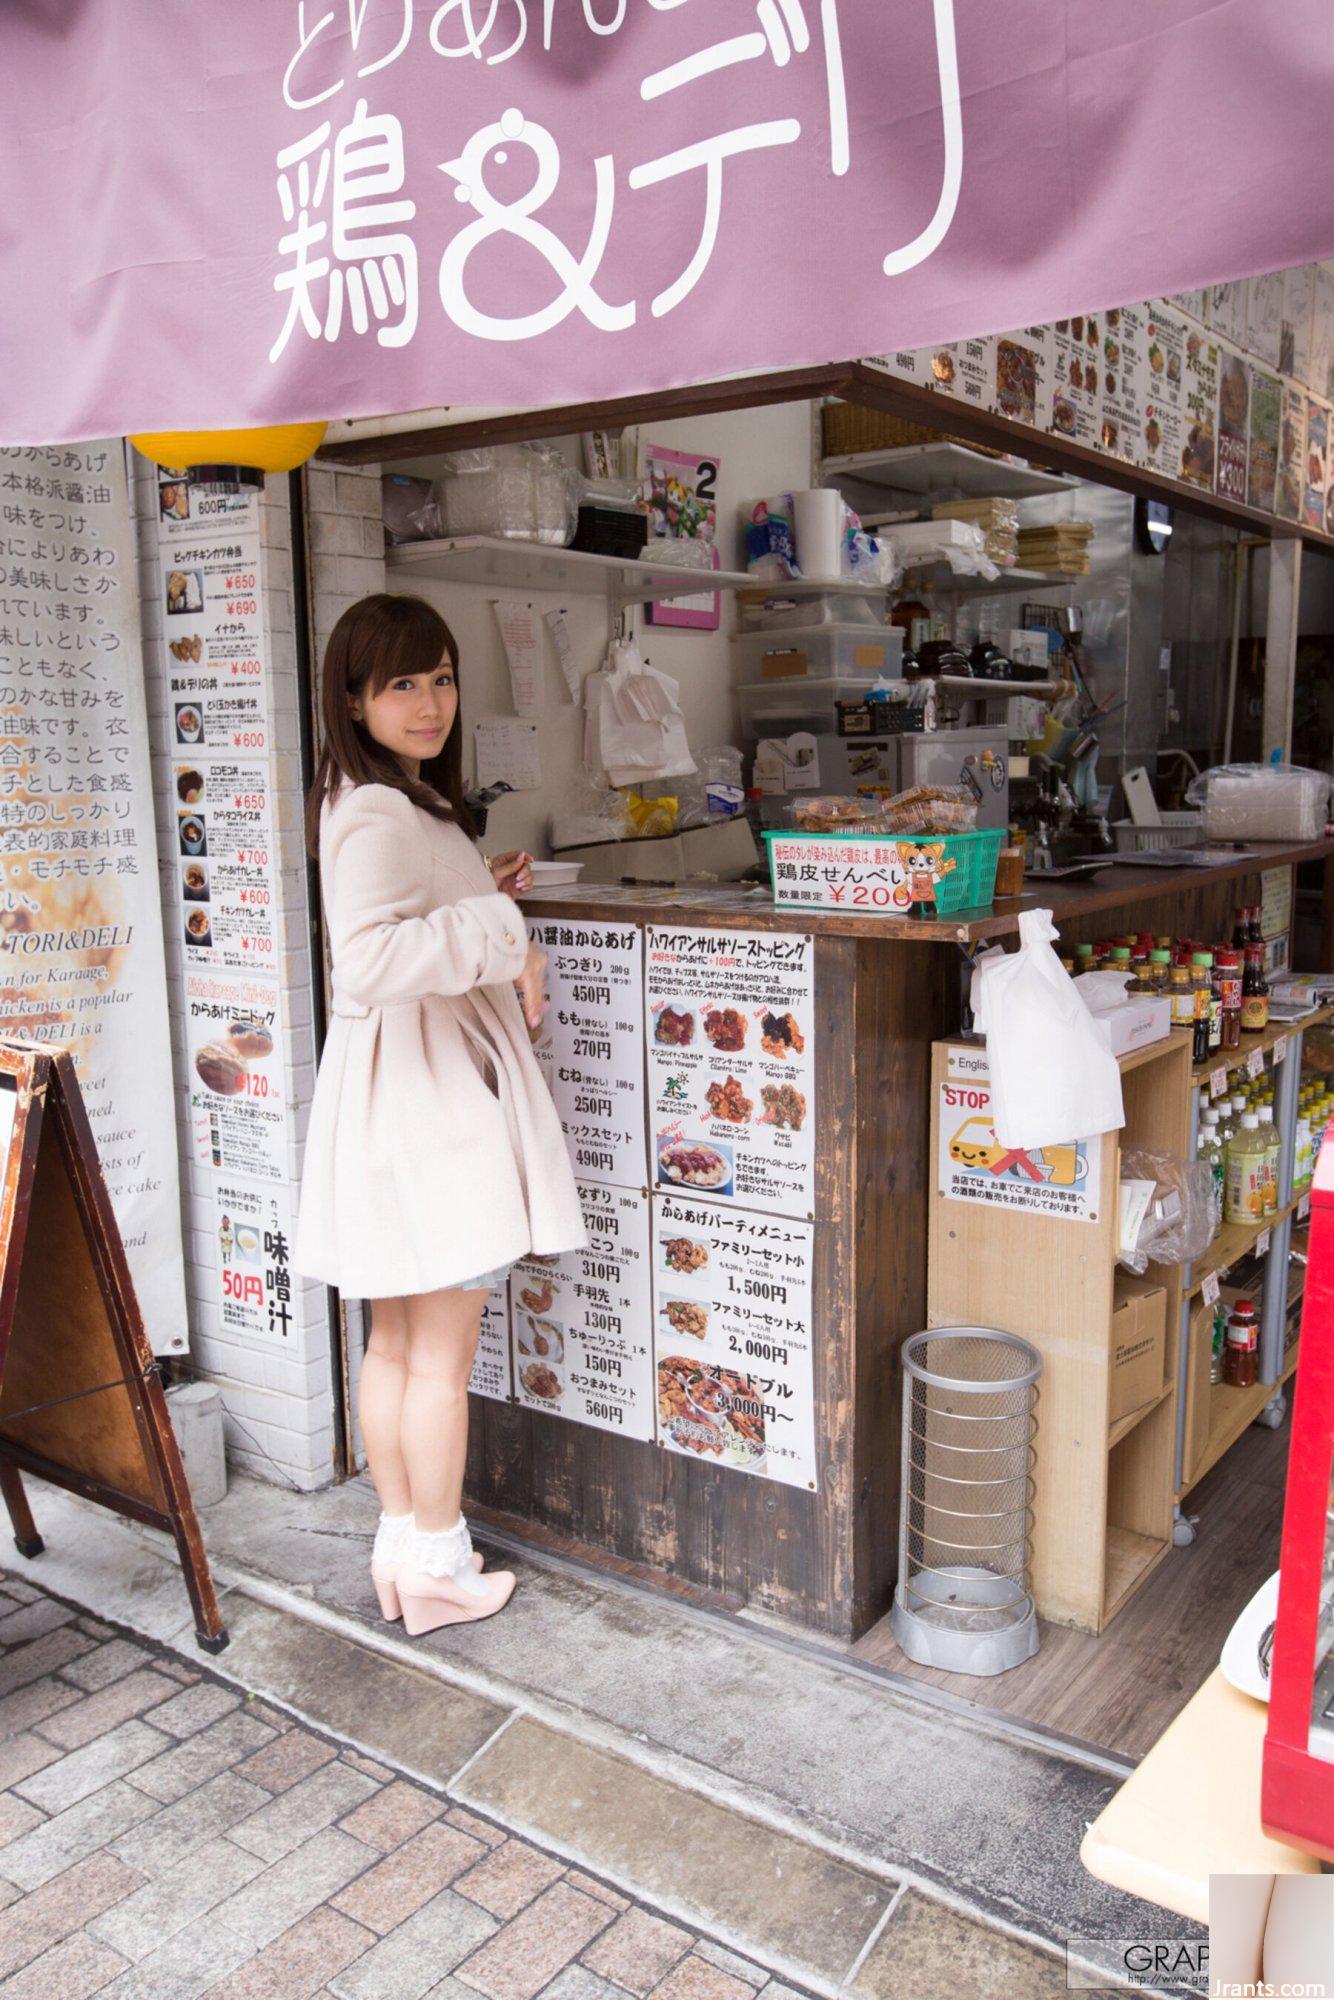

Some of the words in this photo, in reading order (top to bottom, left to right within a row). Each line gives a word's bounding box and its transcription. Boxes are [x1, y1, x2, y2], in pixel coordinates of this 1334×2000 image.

[283, 0, 690, 109] とりあ
[3, 471, 111, 504] 本格派醤油
[696, 461, 717, 499] 2
[0, 856, 139, 881] ・モチモチ感
[778, 889, 823, 902] 数量限定
[829, 884, 912, 906] ¥200
[9, 926, 134, 955] TORI&DELI
[649, 933, 805, 960] ハワイアンサルサソーストッピング
[555, 955, 603, 973] ぶつぎり
[18, 970, 42, 989] for
[50, 999, 61, 1011] is
[67, 999, 75, 1009] a
[79, 989, 134, 1013] popular
[572, 984, 611, 1005] 450円
[190, 1002, 276, 1026] からあげミニドッグ
[35, 1024, 77, 1041] DELI
[80, 1023, 90, 1035] is
[95, 1026, 102, 1035] a
[573, 1038, 611, 1060] 270円
[958, 1056, 990, 1071] Englis
[87, 1101, 116, 1118] ned.
[574, 1095, 612, 1118] 250円
[945, 1088, 990, 1110] STOP
[96, 1129, 136, 1145] sauce
[561, 1121, 633, 1145] ミックスセット
[127, 1151, 144, 1170] of
[576, 1149, 614, 1171] 490円
[127, 1178, 162, 1194] cake
[952, 1174, 1086, 1204] 当店では、お車でご来店のお客様へ
[951, 1186, 1083, 1216] の酒類の販売をお断りしております。
[591, 1237, 614, 1252] こつ
[710, 1238, 805, 1268] ファミリーセット小
[582, 1259, 620, 1284] 310円
[222, 1269, 264, 1306] 50円
[264, 1231, 293, 1337] 味噌汁
[573, 1283, 611, 1304] 手羽先
[727, 1275, 787, 1305] 1,500円
[584, 1310, 621, 1335] 130円
[711, 1301, 806, 1334] ファミリーセット大
[568, 1327, 626, 1351] ちゅーりっぷ
[728, 1335, 789, 1366] 2,000円
[585, 1353, 622, 1378] 150円
[570, 1372, 637, 1399] おつまみセット
[709, 1364, 794, 1399] オードブル
[586, 1399, 623, 1425] 560円
